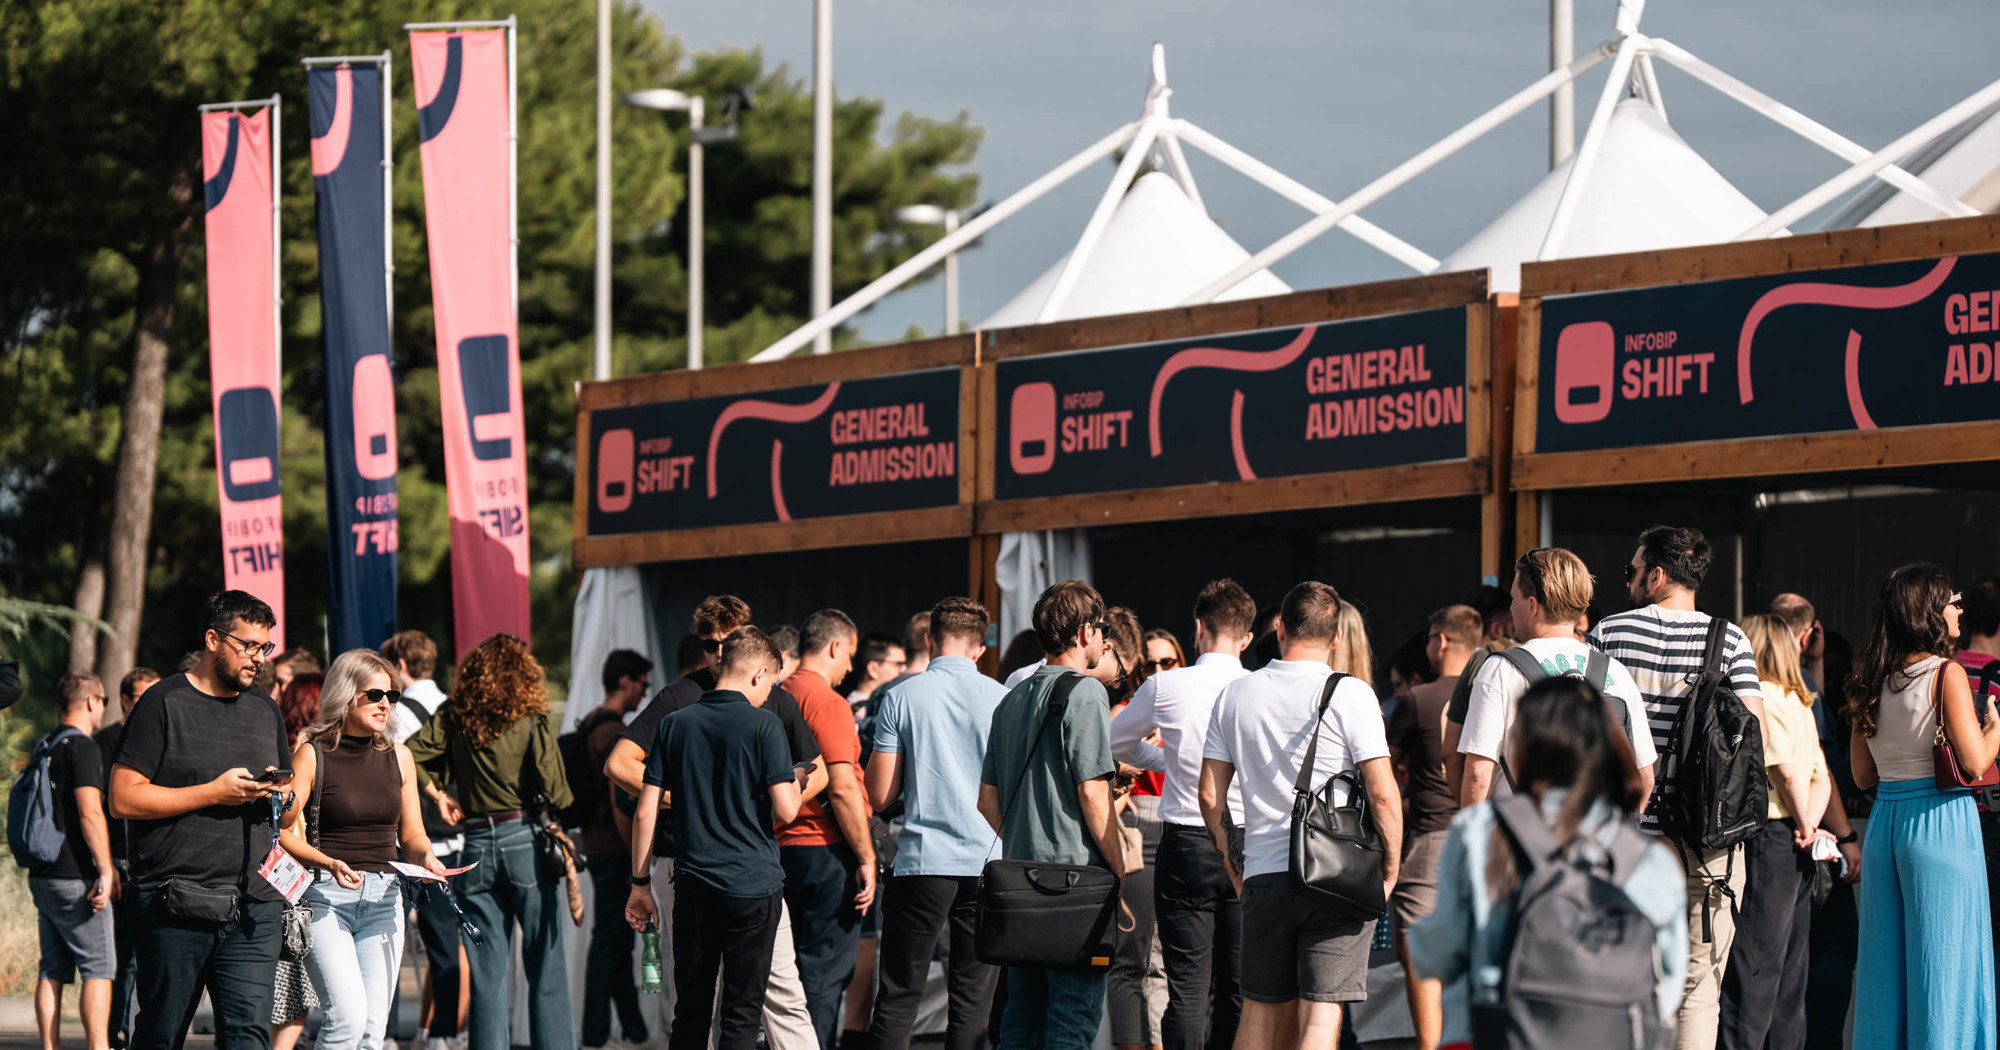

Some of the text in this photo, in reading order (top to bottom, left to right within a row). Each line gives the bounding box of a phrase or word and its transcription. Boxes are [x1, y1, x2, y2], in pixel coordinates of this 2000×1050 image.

[1625, 330, 1677, 352] INFOBIP
[1306, 344, 1431, 395] GENERAL
[1621, 352, 1715, 400] SHIFT
[1943, 341, 2000, 386] AD
[1063, 390, 1104, 410] INFOBIP
[1305, 385, 1463, 440] ADMISSION
[831, 402, 930, 445] GENERAL
[1061, 410, 1132, 453] SHIFT
[637, 455, 694, 493] SHIFT
[829, 440, 955, 486] ADMISSION
